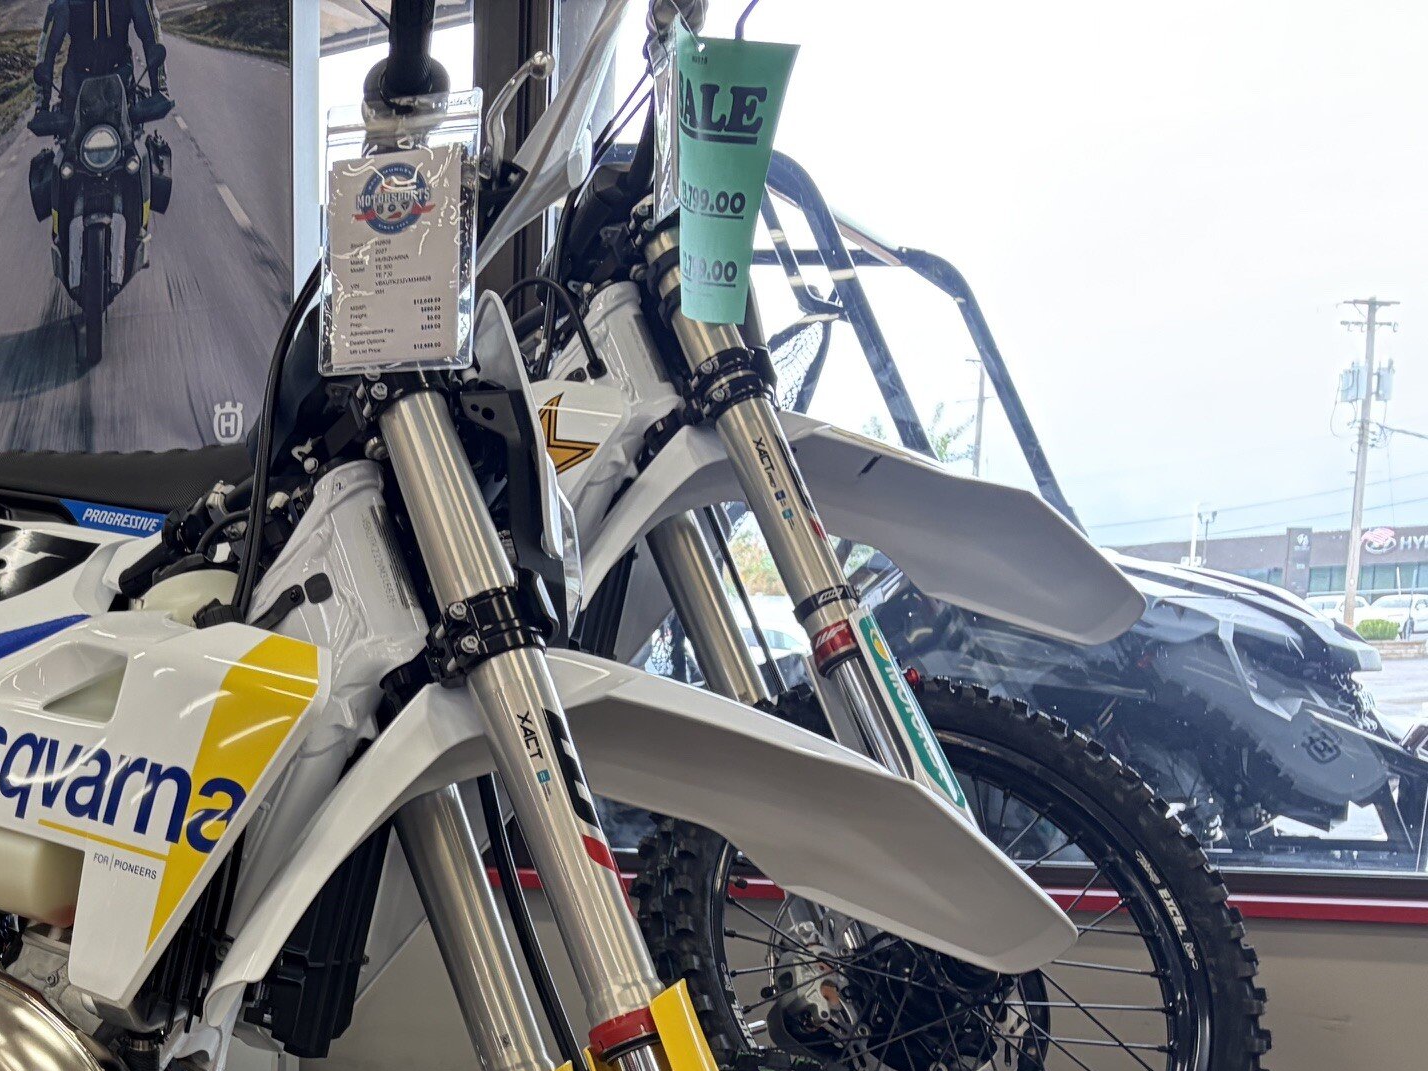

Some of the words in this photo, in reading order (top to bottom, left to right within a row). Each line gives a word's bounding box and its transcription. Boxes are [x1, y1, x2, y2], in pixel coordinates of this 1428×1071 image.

[753, 436, 775, 471] XACT
[82, 507, 161, 533] PROGRESSIVE
[516, 710, 543, 760] XACT
[93, 852, 109, 865] FOR
[113, 859, 157, 880] PIONEERS
